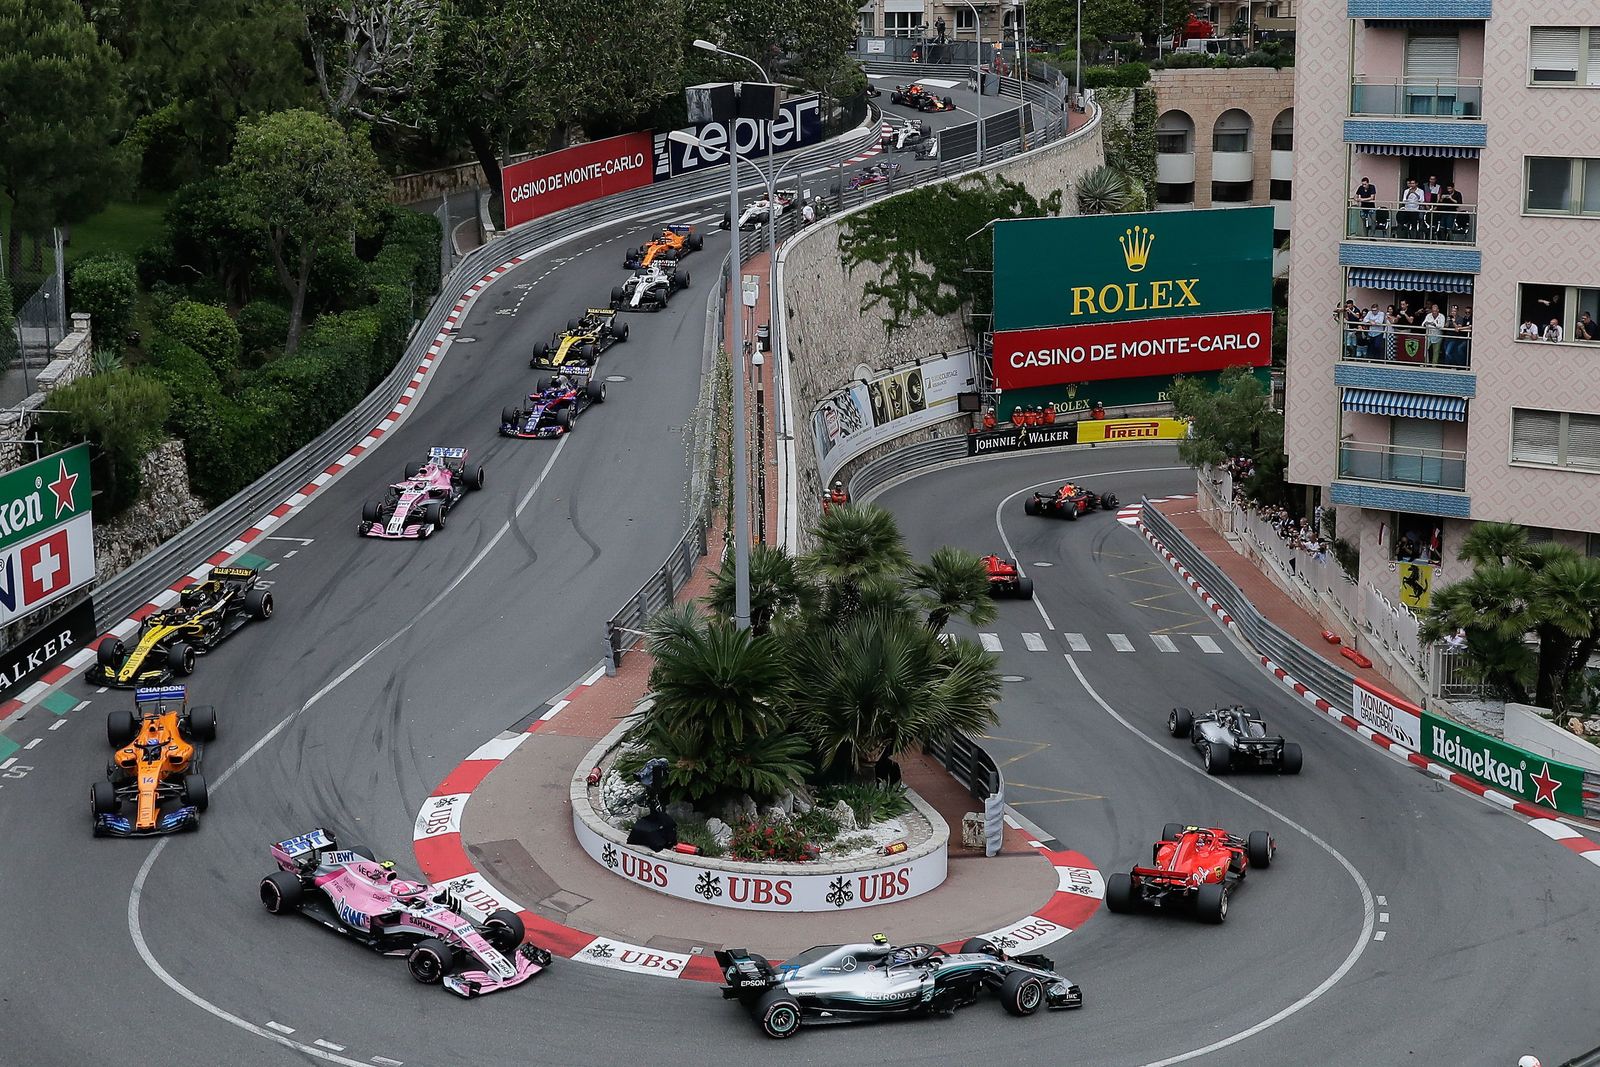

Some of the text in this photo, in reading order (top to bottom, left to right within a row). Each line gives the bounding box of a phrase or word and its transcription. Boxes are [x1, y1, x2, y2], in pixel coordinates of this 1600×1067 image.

[509, 151, 645, 203] CASINO DE MONTE-CARLO
[1070, 278, 1201, 316] ROLEX
[1009, 332, 1261, 369] CASINO DE MONTE-CARLO
[1053, 399, 1090, 413] ROLEX
[975, 431, 1069, 453] JOHNNIE WALKER
[1104, 422, 1159, 439] PIRELLI
[139, 685, 182, 694] CHANDON
[1360, 690, 1394, 723] MONACO
[1432, 725, 1525, 794] Heineken
[426, 807, 453, 834] UBS
[337, 851, 355, 863] BWT
[621, 851, 669, 888] UBS
[727, 876, 793, 904] UBS
[858, 867, 912, 902] UBS
[1009, 919, 1057, 941] UBS
[620, 949, 684, 974] UBS
[779, 964, 801, 982] 77
[740, 979, 766, 988] EPSON
[864, 990, 917, 1001] PETRONAS
